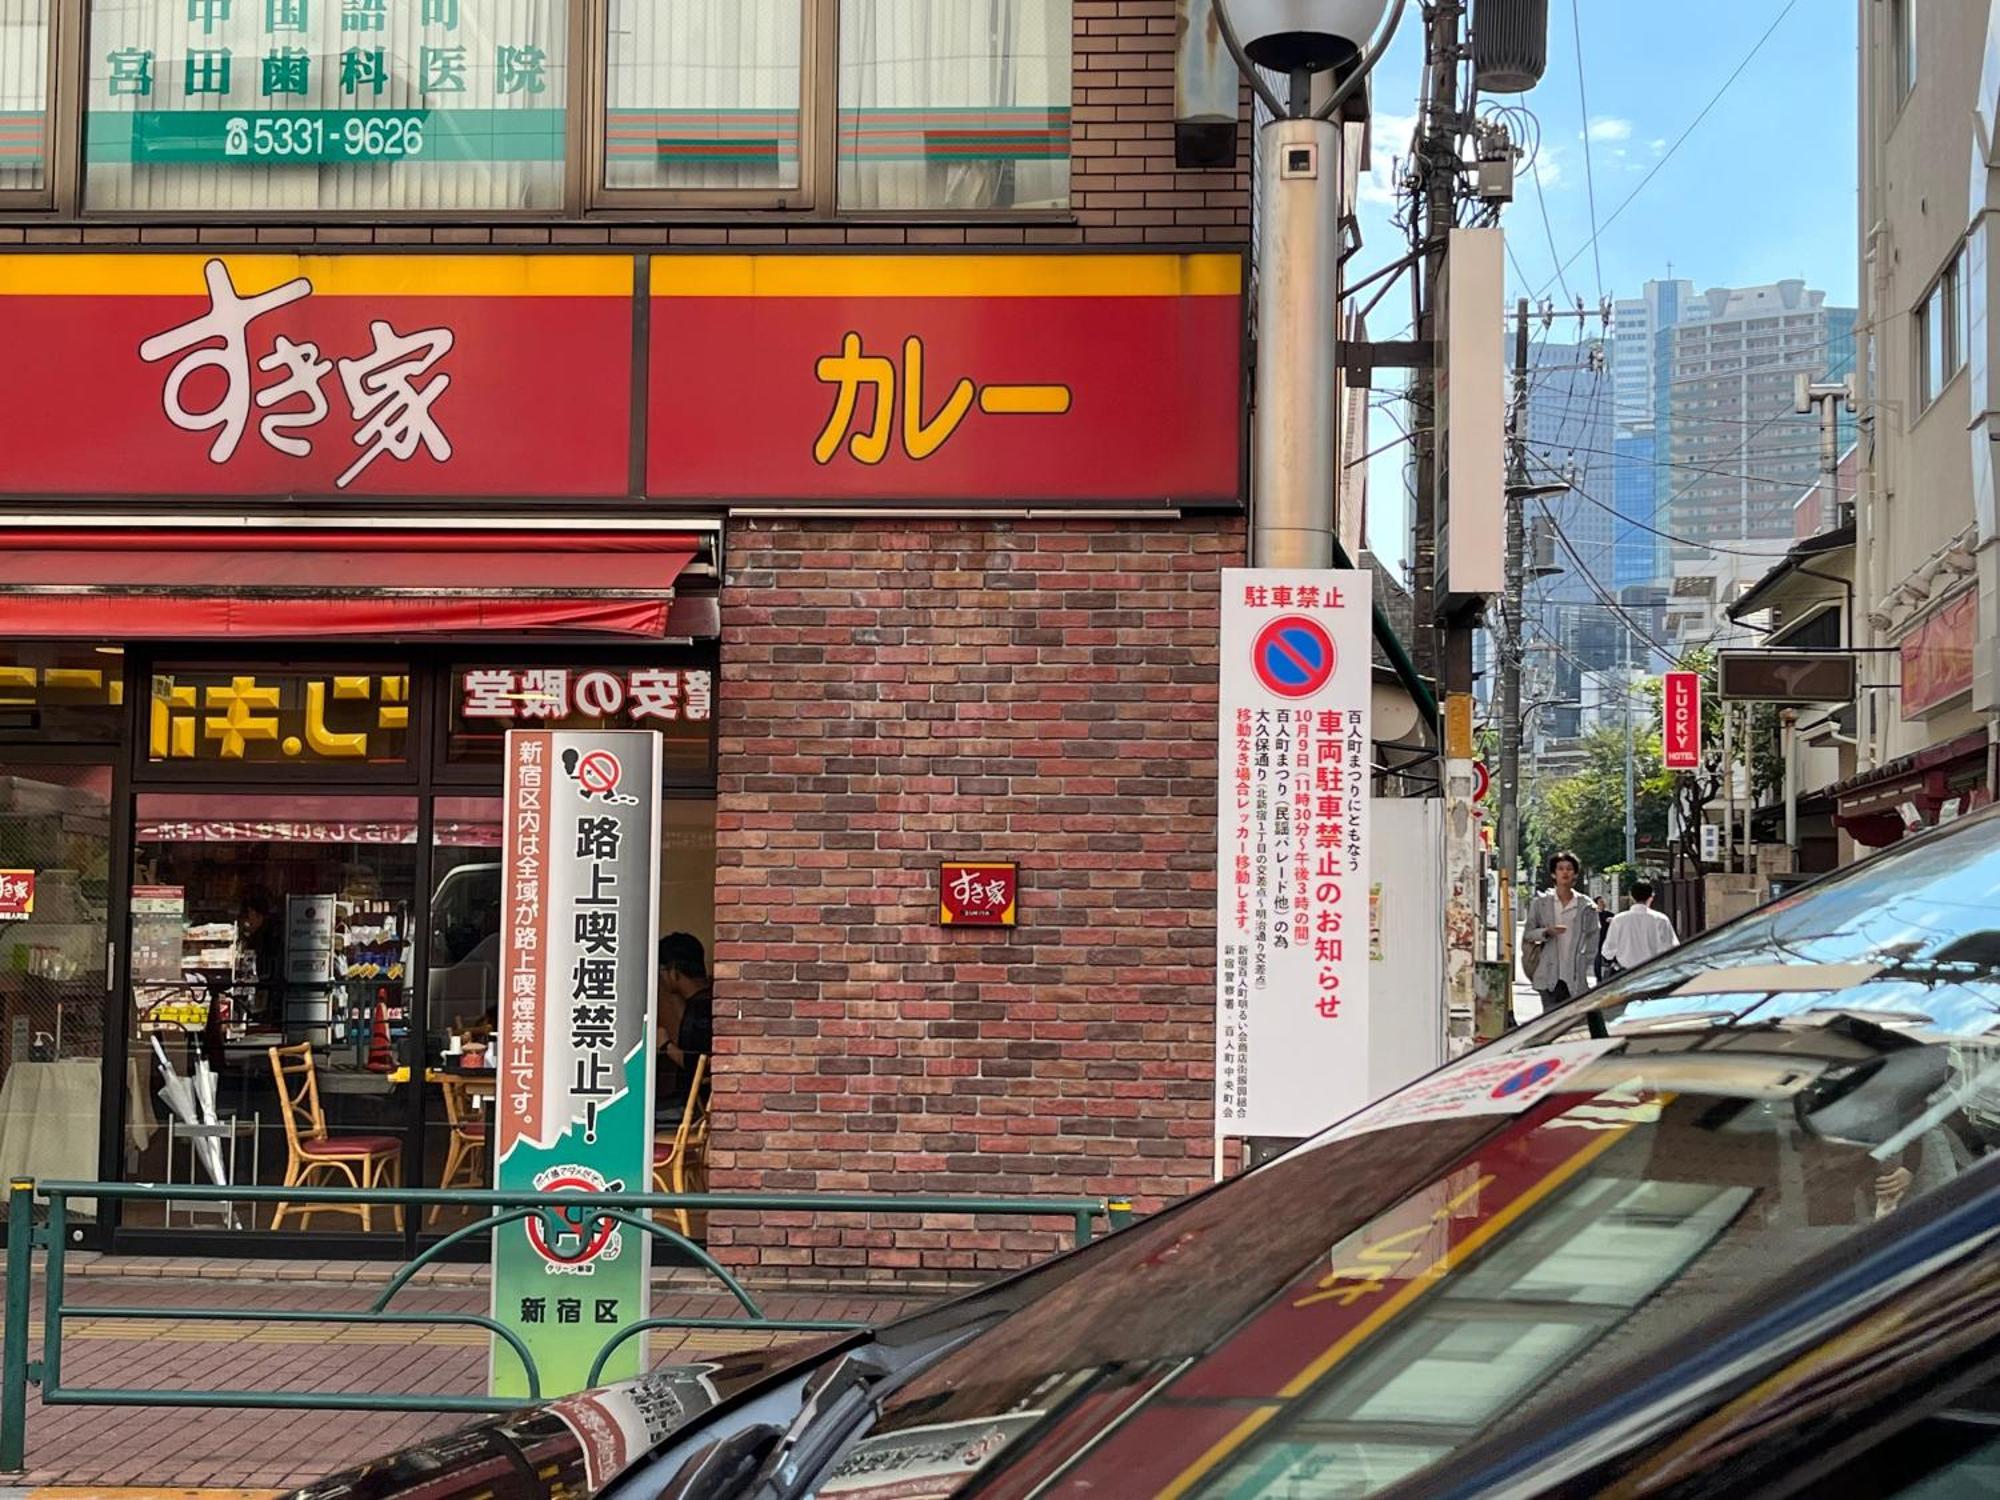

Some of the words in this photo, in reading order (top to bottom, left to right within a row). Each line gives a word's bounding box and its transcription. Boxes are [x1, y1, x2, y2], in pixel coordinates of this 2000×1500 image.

[106, 45, 548, 97] 宮田歯科医院
[253, 117, 424, 156] 5331-9626
[139, 257, 455, 489] すき家
[812, 330, 1073, 466] カレー
[1244, 586, 1345, 608] 駐車禁止
[1675, 681, 1687, 748] LUCKY
[1668, 752, 1696, 760] HOTEL
[1347, 709, 1363, 872] 百人町まつりにともなう
[949, 869, 1006, 910] すき家
[1314, 709, 1344, 1019] 車両駐車禁止のお知らせ
[511, 741, 543, 1125] 新宿区内は全域が路上喫煙禁止です。
[521, 1297, 619, 1324] 新宿区
